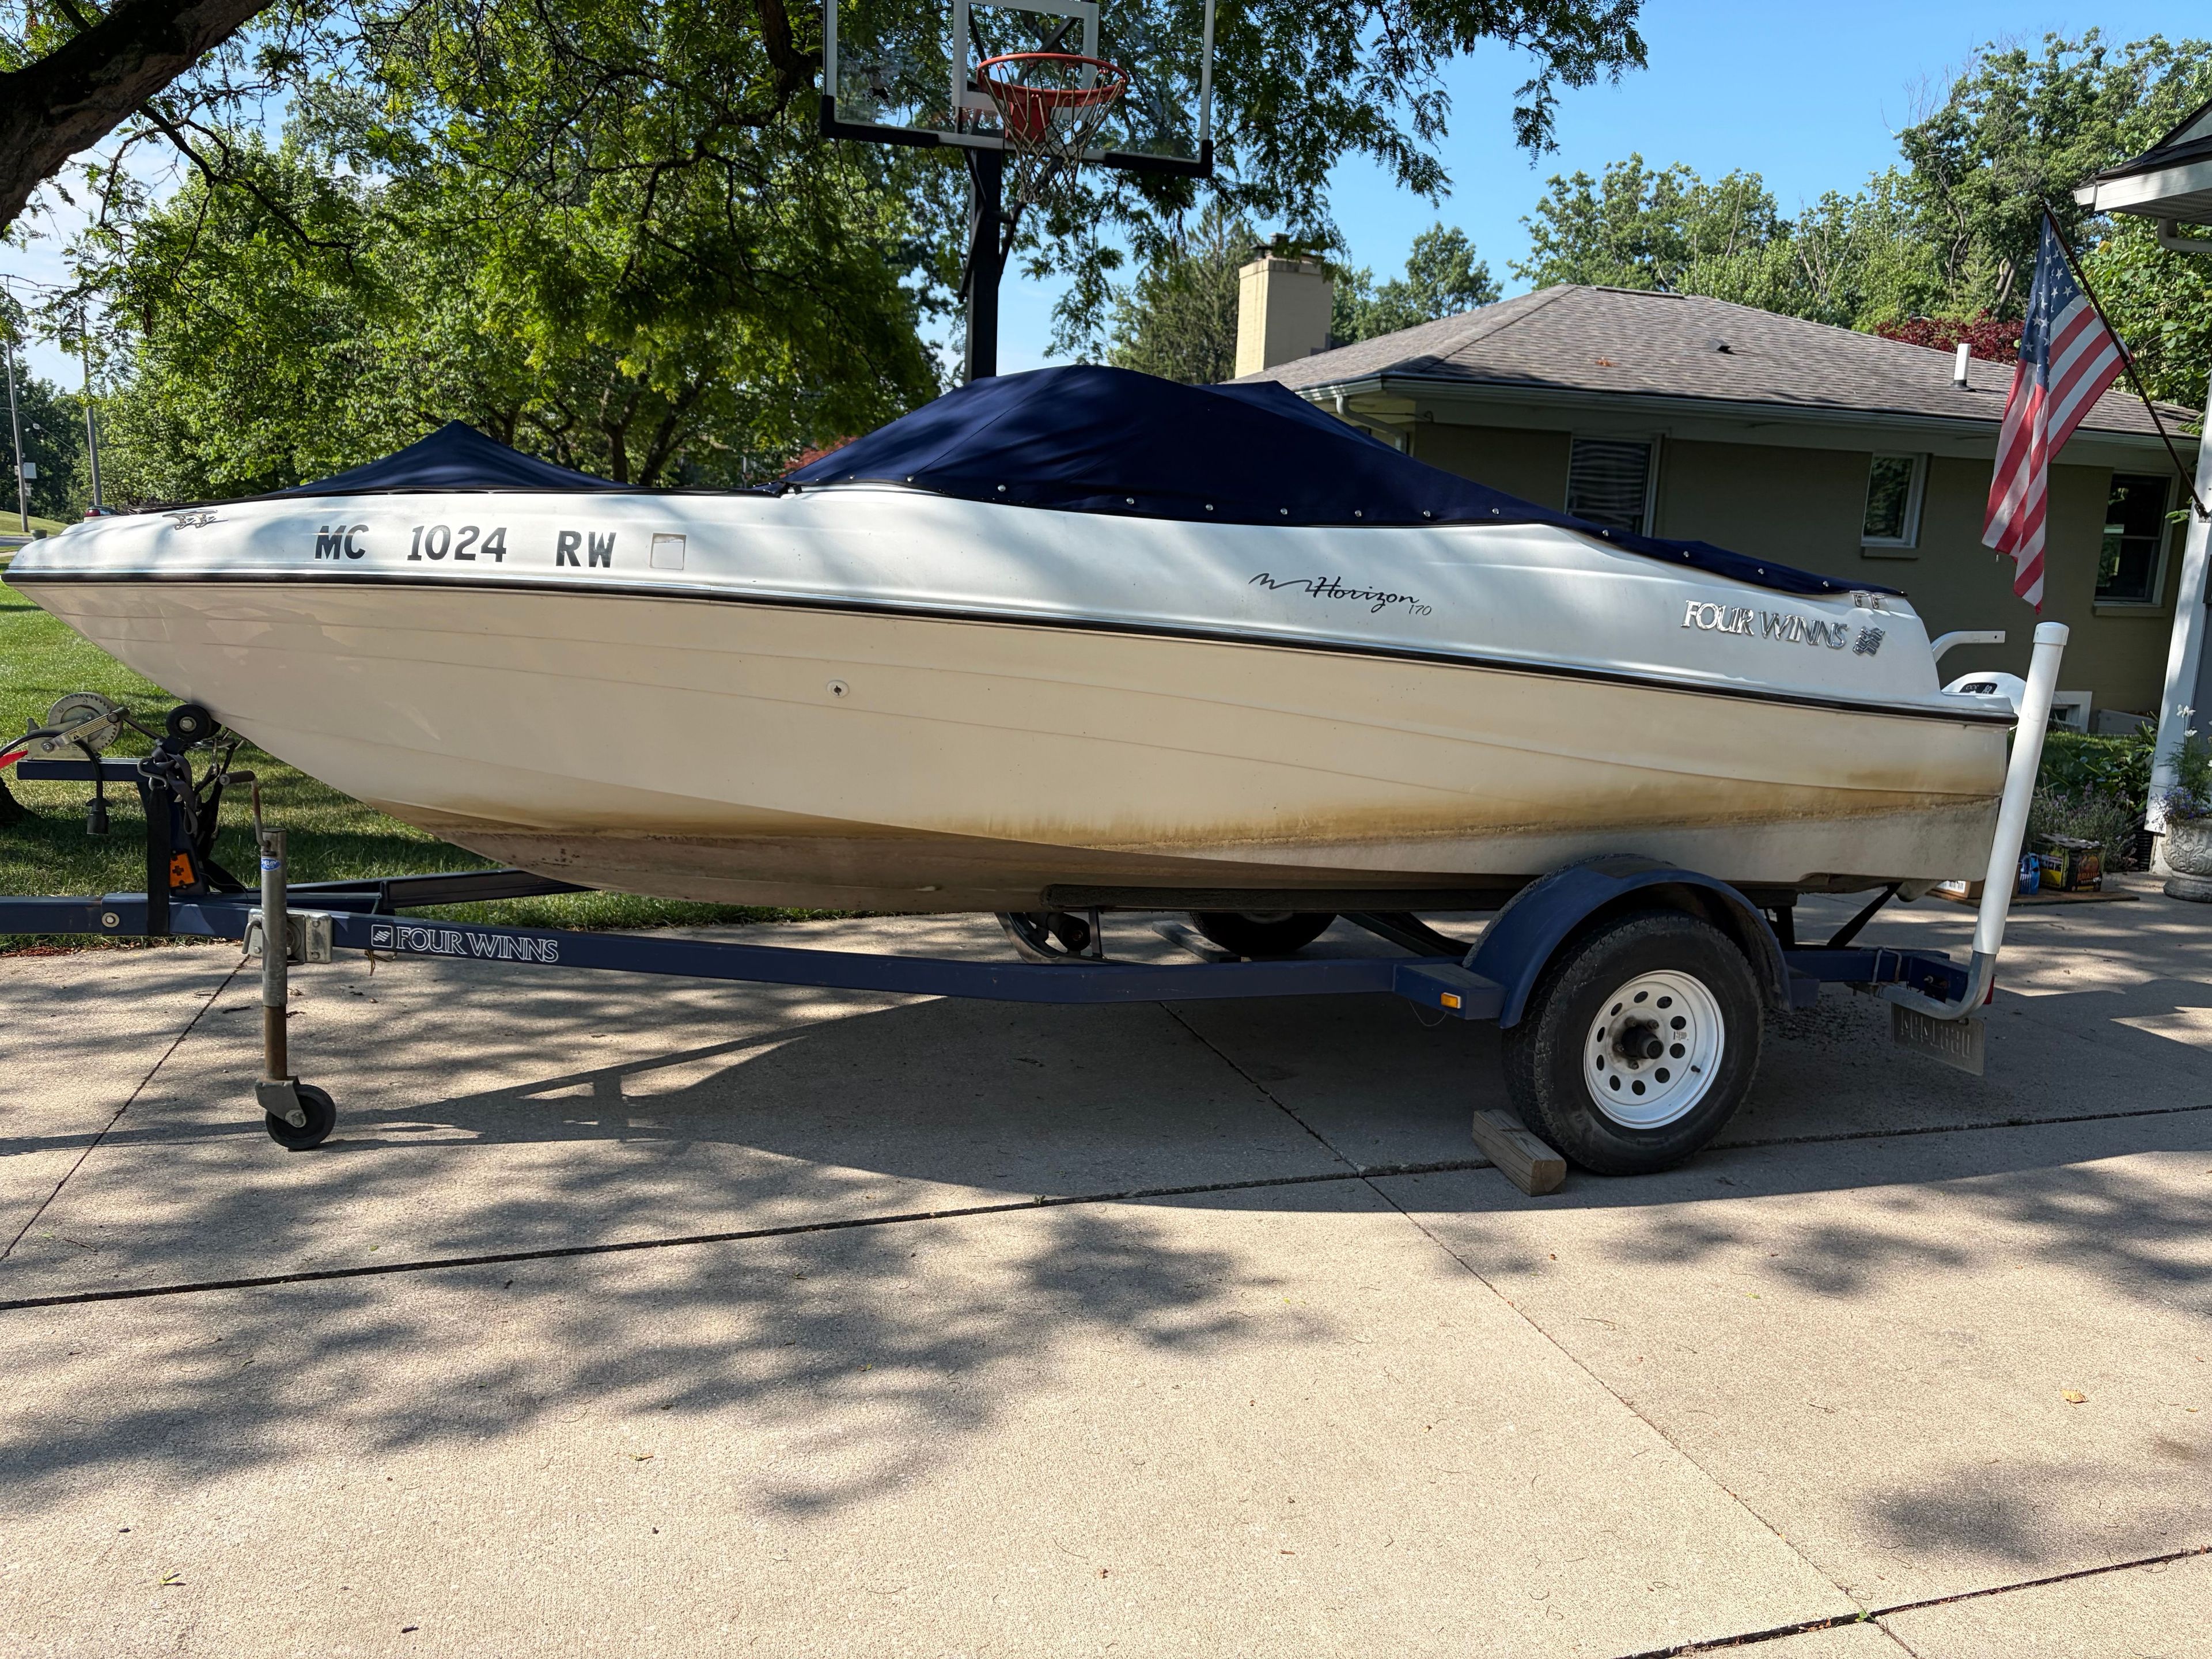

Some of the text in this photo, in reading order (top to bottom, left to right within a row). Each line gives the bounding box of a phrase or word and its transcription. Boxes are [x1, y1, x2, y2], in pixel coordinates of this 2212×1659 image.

[314, 524, 617, 568] MC 1024 RW
[1313, 576, 1432, 616] Horizon 170
[1680, 600, 1849, 650] FOUR WINNS
[395, 926, 559, 963] FOUR WINNS
